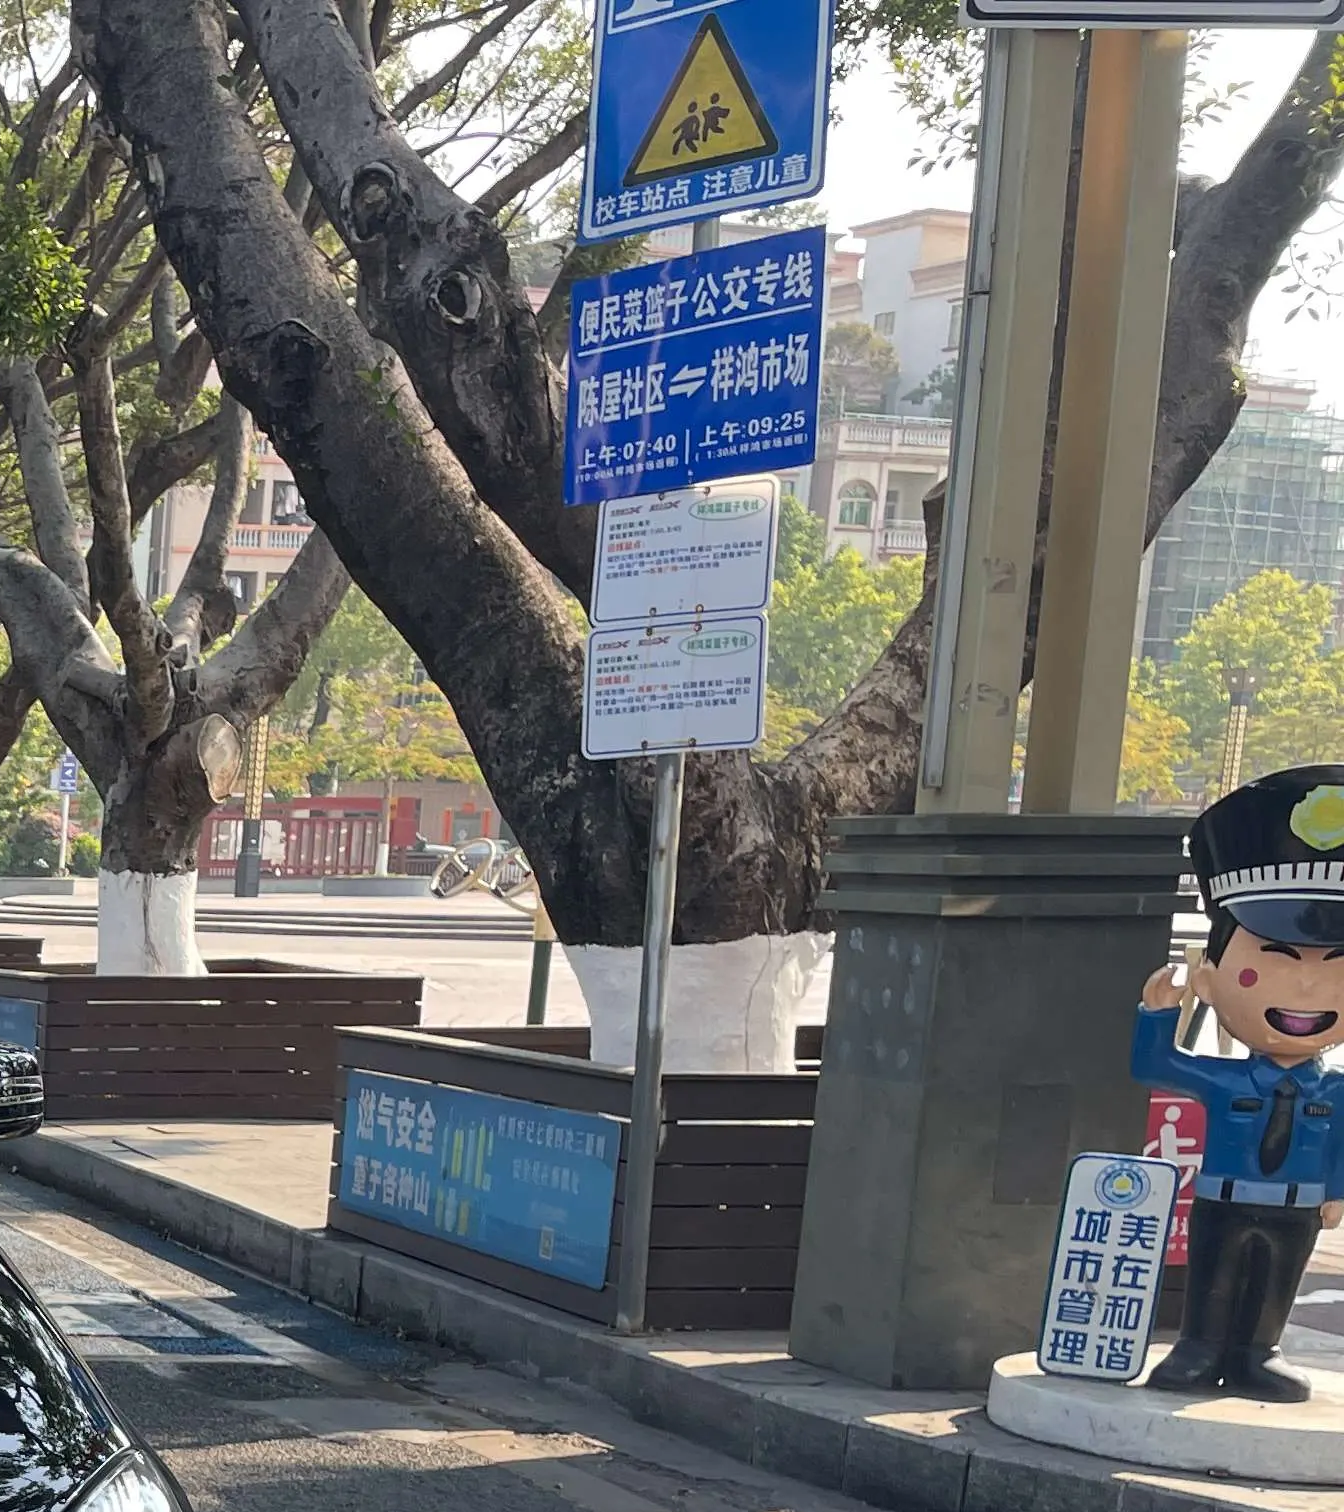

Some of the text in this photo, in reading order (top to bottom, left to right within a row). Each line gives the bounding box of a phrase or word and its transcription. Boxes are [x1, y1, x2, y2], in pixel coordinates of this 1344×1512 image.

[595, 153, 808, 225] 校车站点 注意儿童
[578, 250, 814, 347] 便民菜篮子公交专线
[577, 332, 810, 429] 陈屋社区 祥鸿市场
[355, 1086, 437, 1155] 燃气安全
[1046, 1205, 1112, 1367] 城市管理
[1095, 1213, 1161, 1373] 美在和谐
